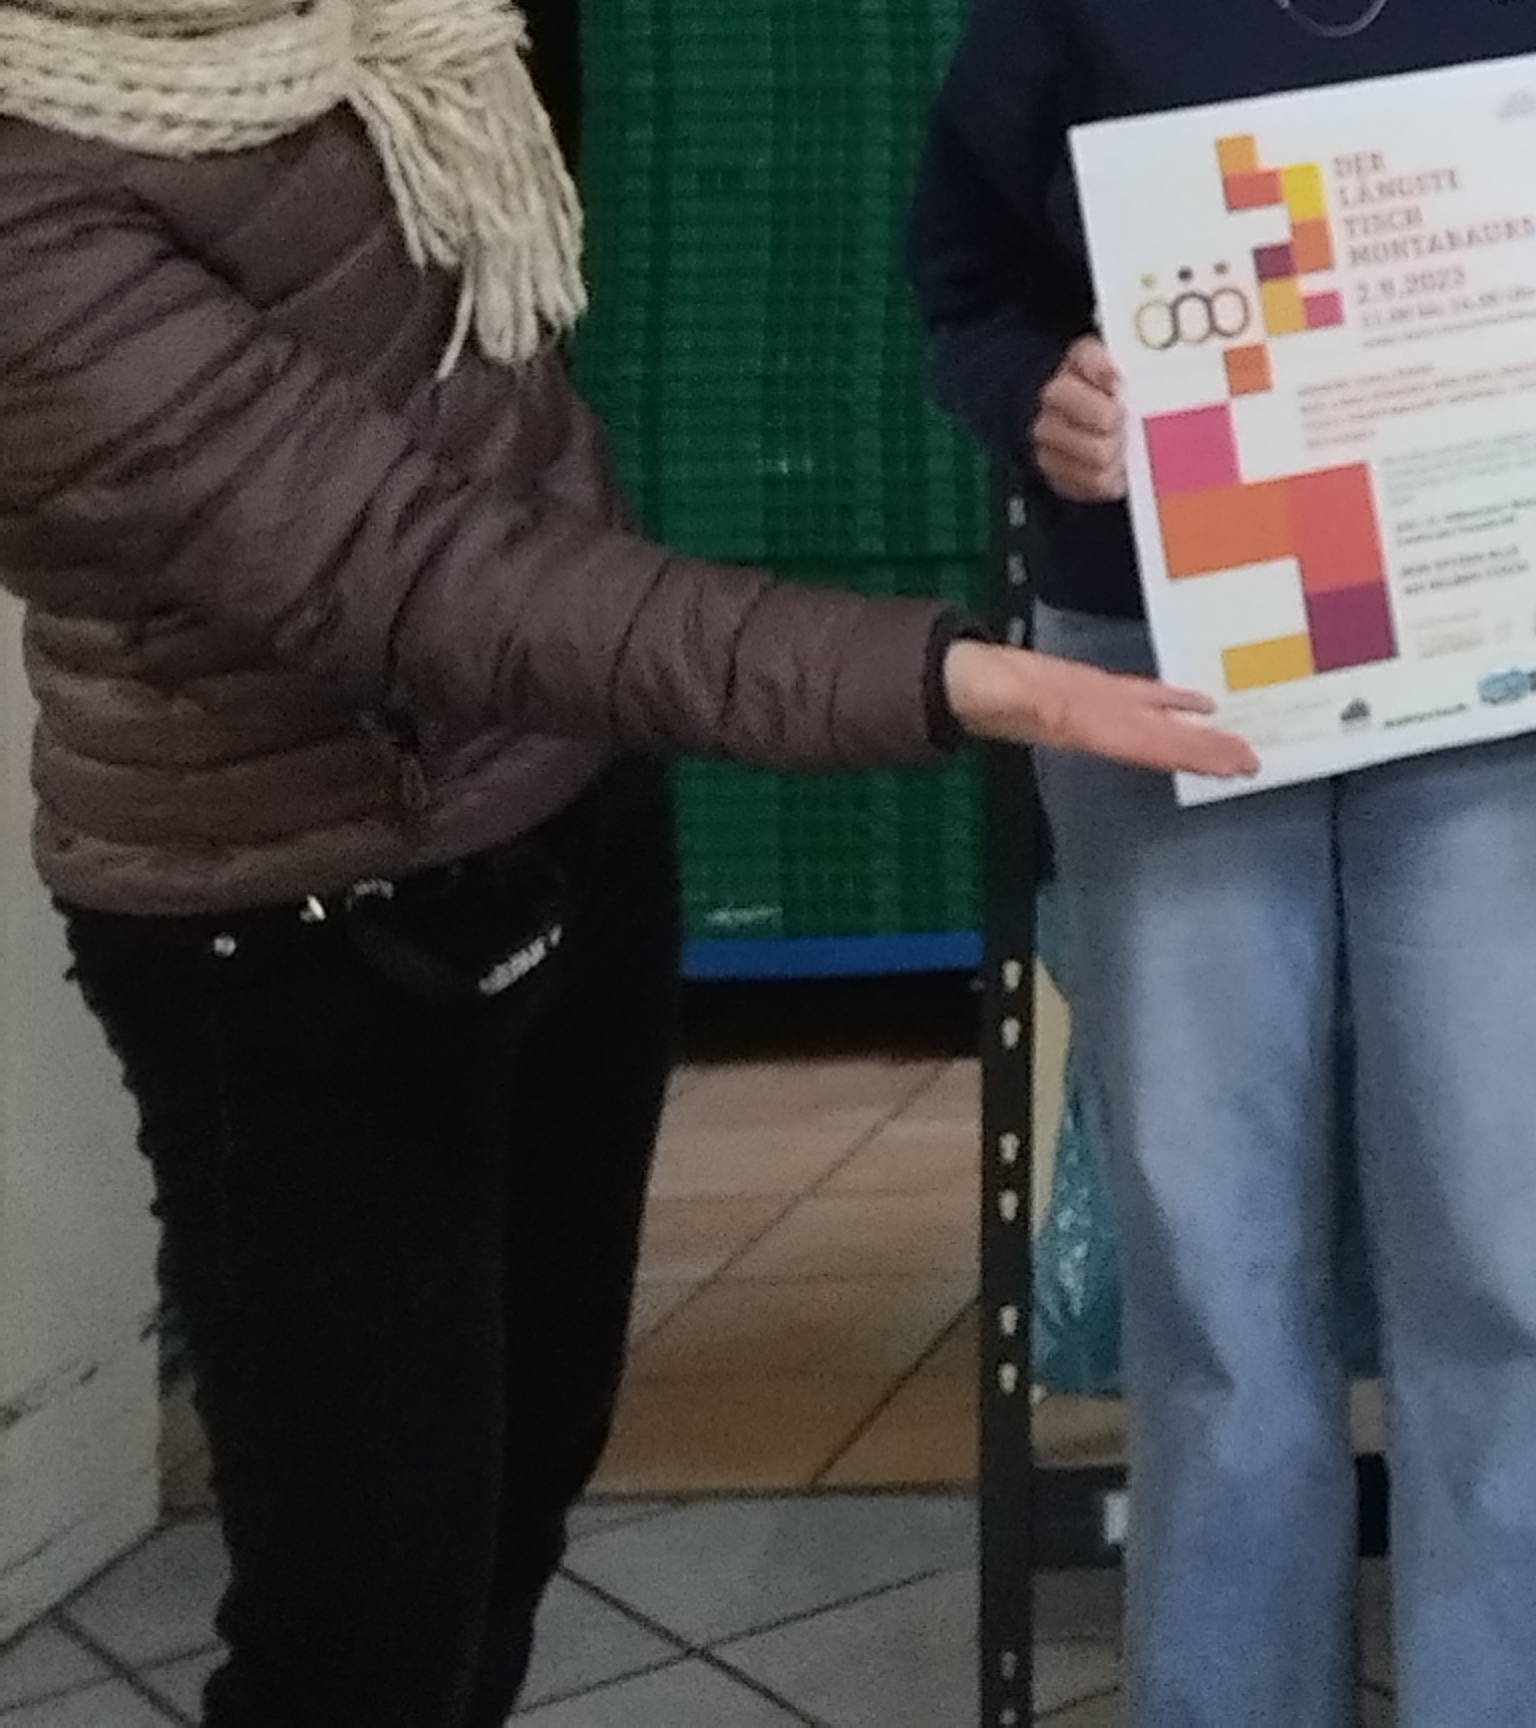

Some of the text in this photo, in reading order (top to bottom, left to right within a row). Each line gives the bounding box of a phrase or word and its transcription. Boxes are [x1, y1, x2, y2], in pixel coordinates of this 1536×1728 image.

[1334, 152, 1386, 178] DER
[1342, 206, 1423, 239] TISCH
[1349, 216, 1536, 267] MONTABAURS
